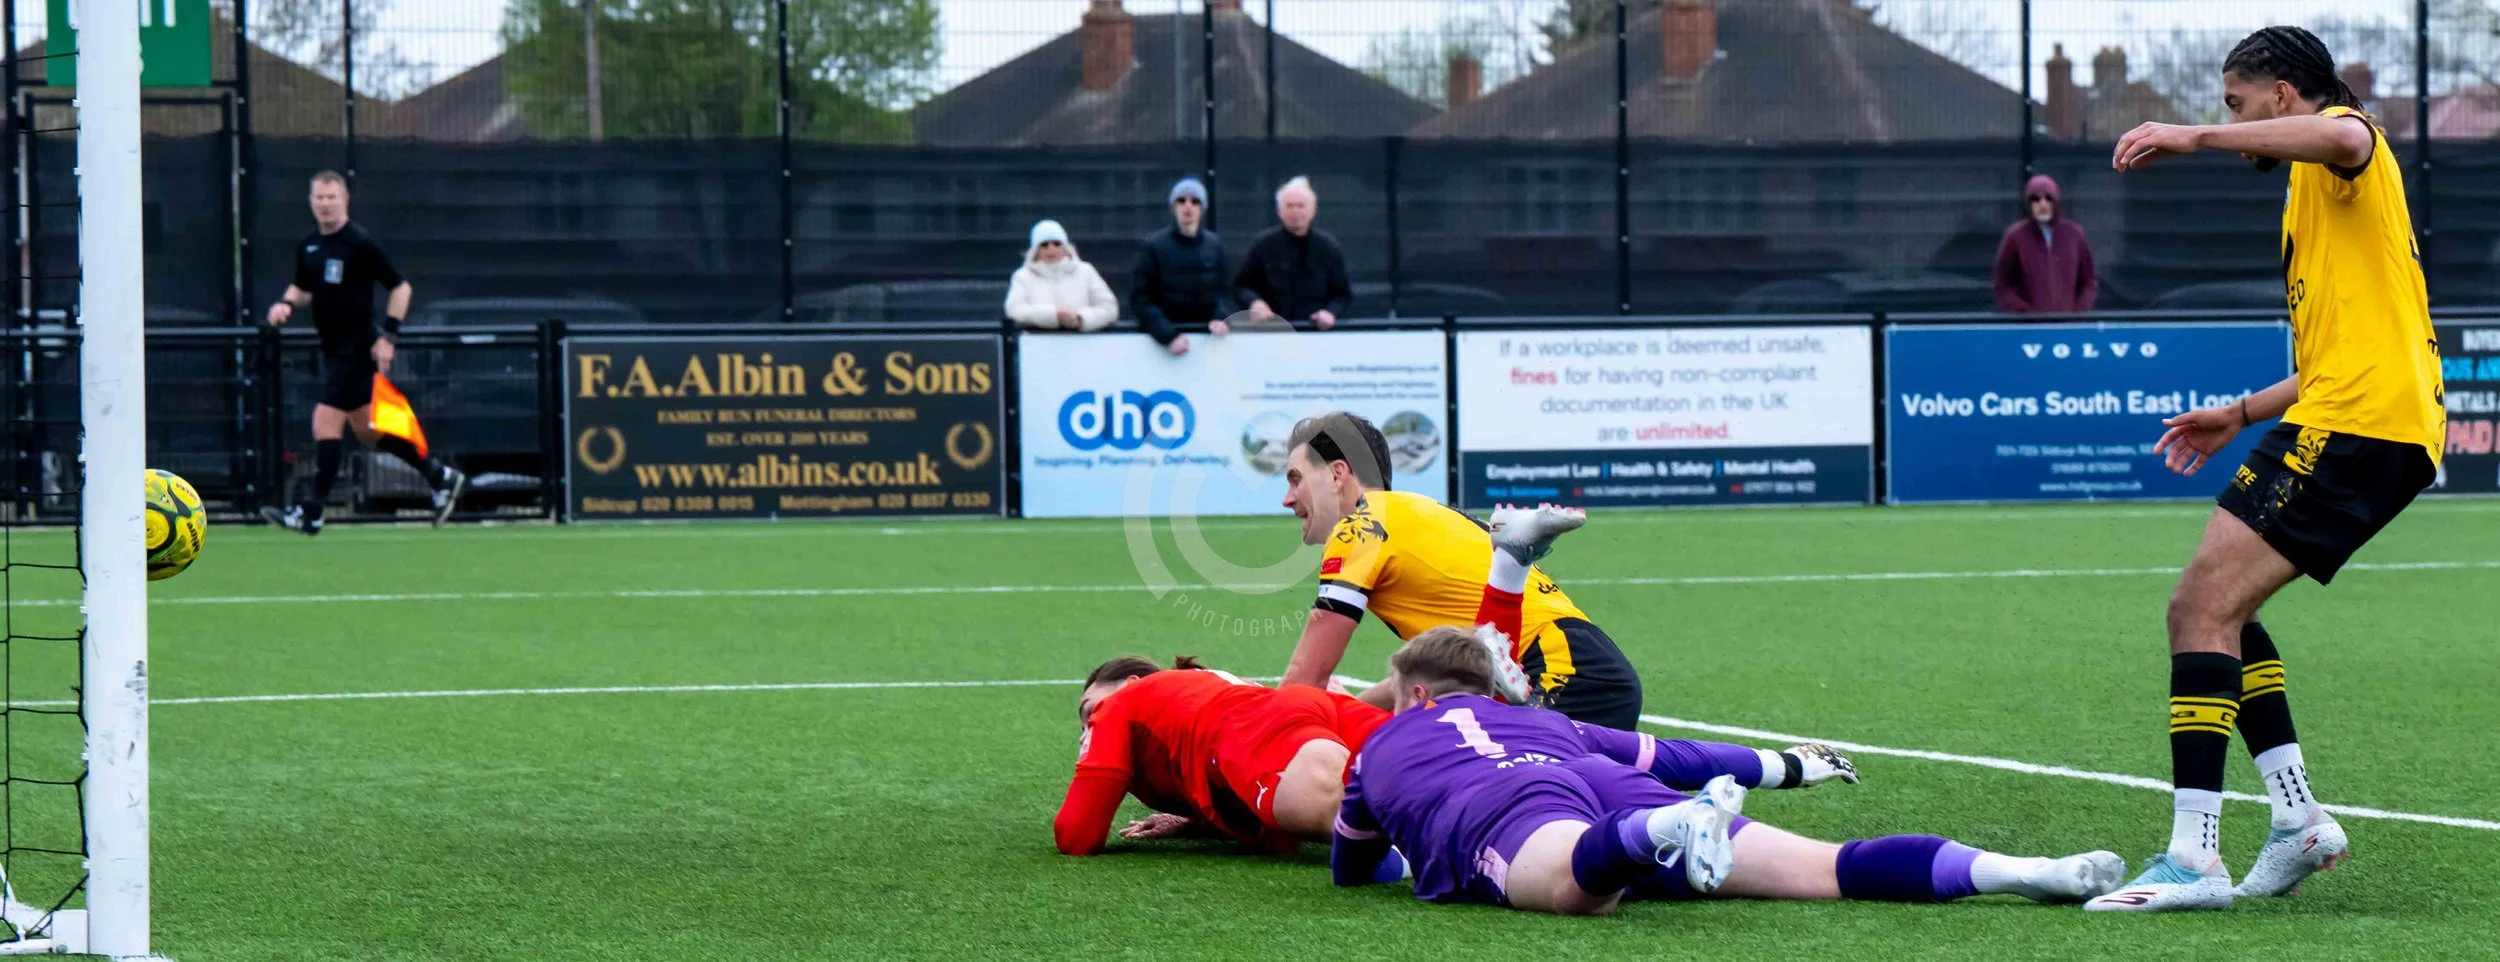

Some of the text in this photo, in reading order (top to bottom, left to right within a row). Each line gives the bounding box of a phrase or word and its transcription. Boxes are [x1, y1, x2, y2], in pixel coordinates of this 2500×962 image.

[1500, 333, 1827, 360] If a workplace is deemed unsafe,
[2021, 342, 2159, 359] VOLVO
[577, 351, 992, 398] F.A.Albin & Sons
[1510, 362, 1818, 387] fines for having non-compliant
[1540, 391, 1788, 414] documentation in the UK
[1901, 392, 1975, 417] Volvo
[1980, 391, 2040, 416] Cars
[2045, 390, 2122, 416] South
[2127, 389, 2184, 414] East
[656, 409, 714, 424] FAMILY
[754, 408, 824, 424] FUNERAL
[828, 407, 918, 422] DIRECTORS
[1066, 389, 1188, 443] dha
[741, 431, 785, 446] OVER
[819, 430, 870, 445] YEARS
[1597, 427, 1629, 441] are
[633, 452, 942, 489] www.albins.co.uk
[1486, 457, 1817, 482] Employment Law Health & Safety Mental Health
[1436, 708, 1508, 759] 1
